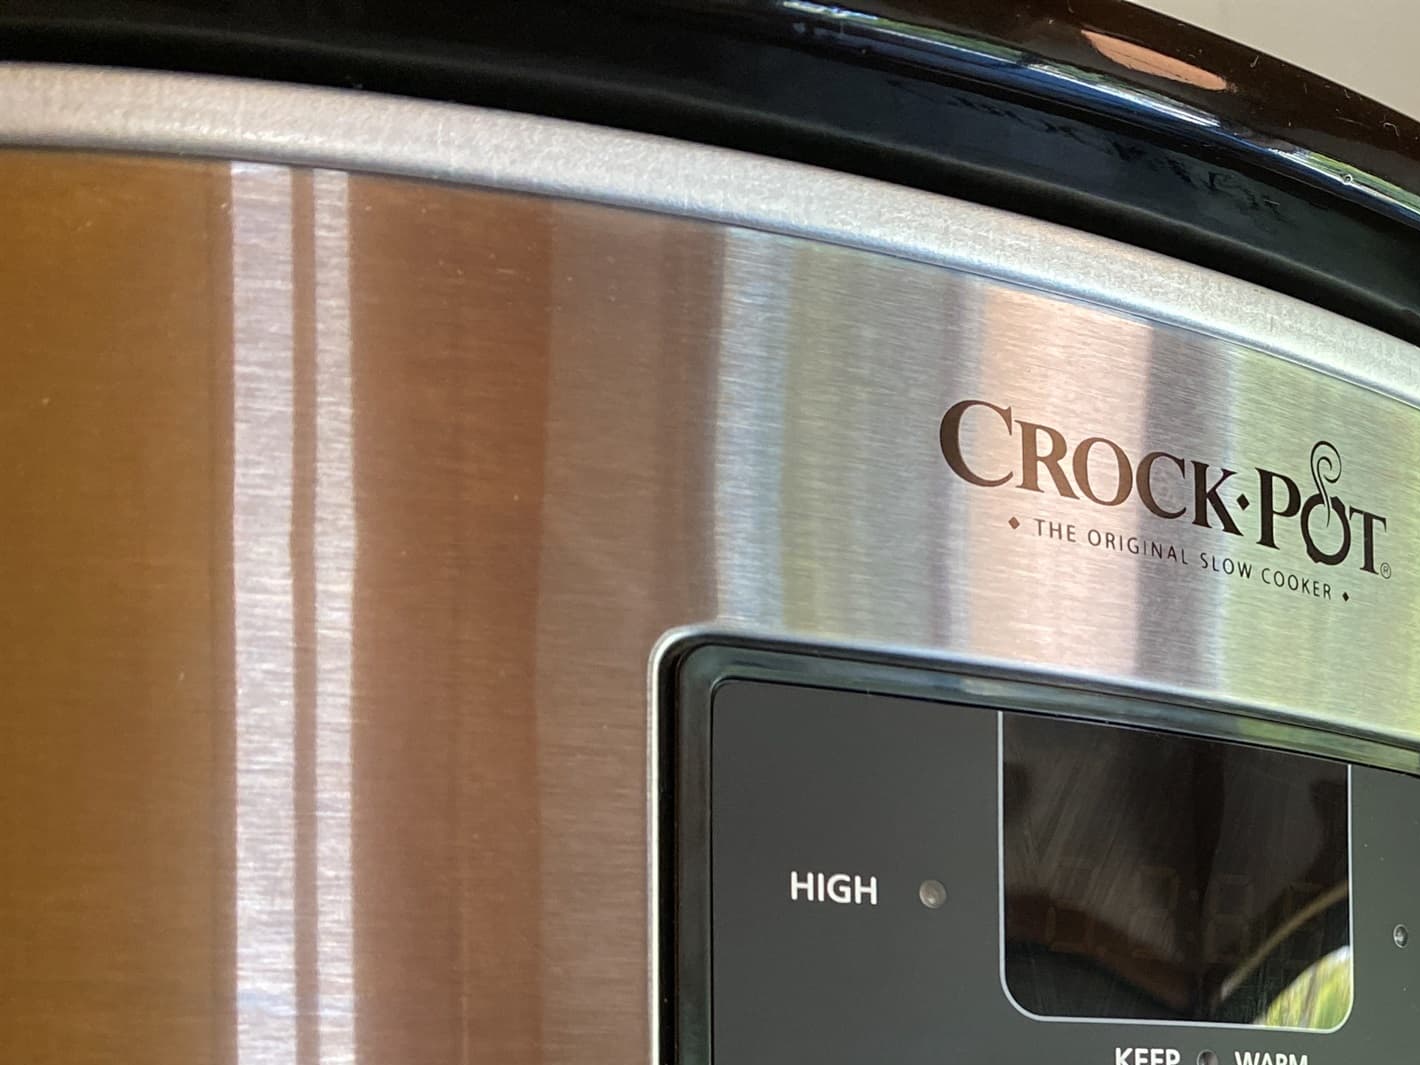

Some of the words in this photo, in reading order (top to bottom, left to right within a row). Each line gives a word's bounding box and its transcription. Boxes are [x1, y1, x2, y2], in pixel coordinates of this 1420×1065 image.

[1033, 518, 1077, 544] THE
[1087, 528, 1189, 566] ORIGINAL
[1199, 551, 1253, 580] SLOW
[1261, 566, 1332, 601] COOKER
[790, 870, 878, 906] HIGH
